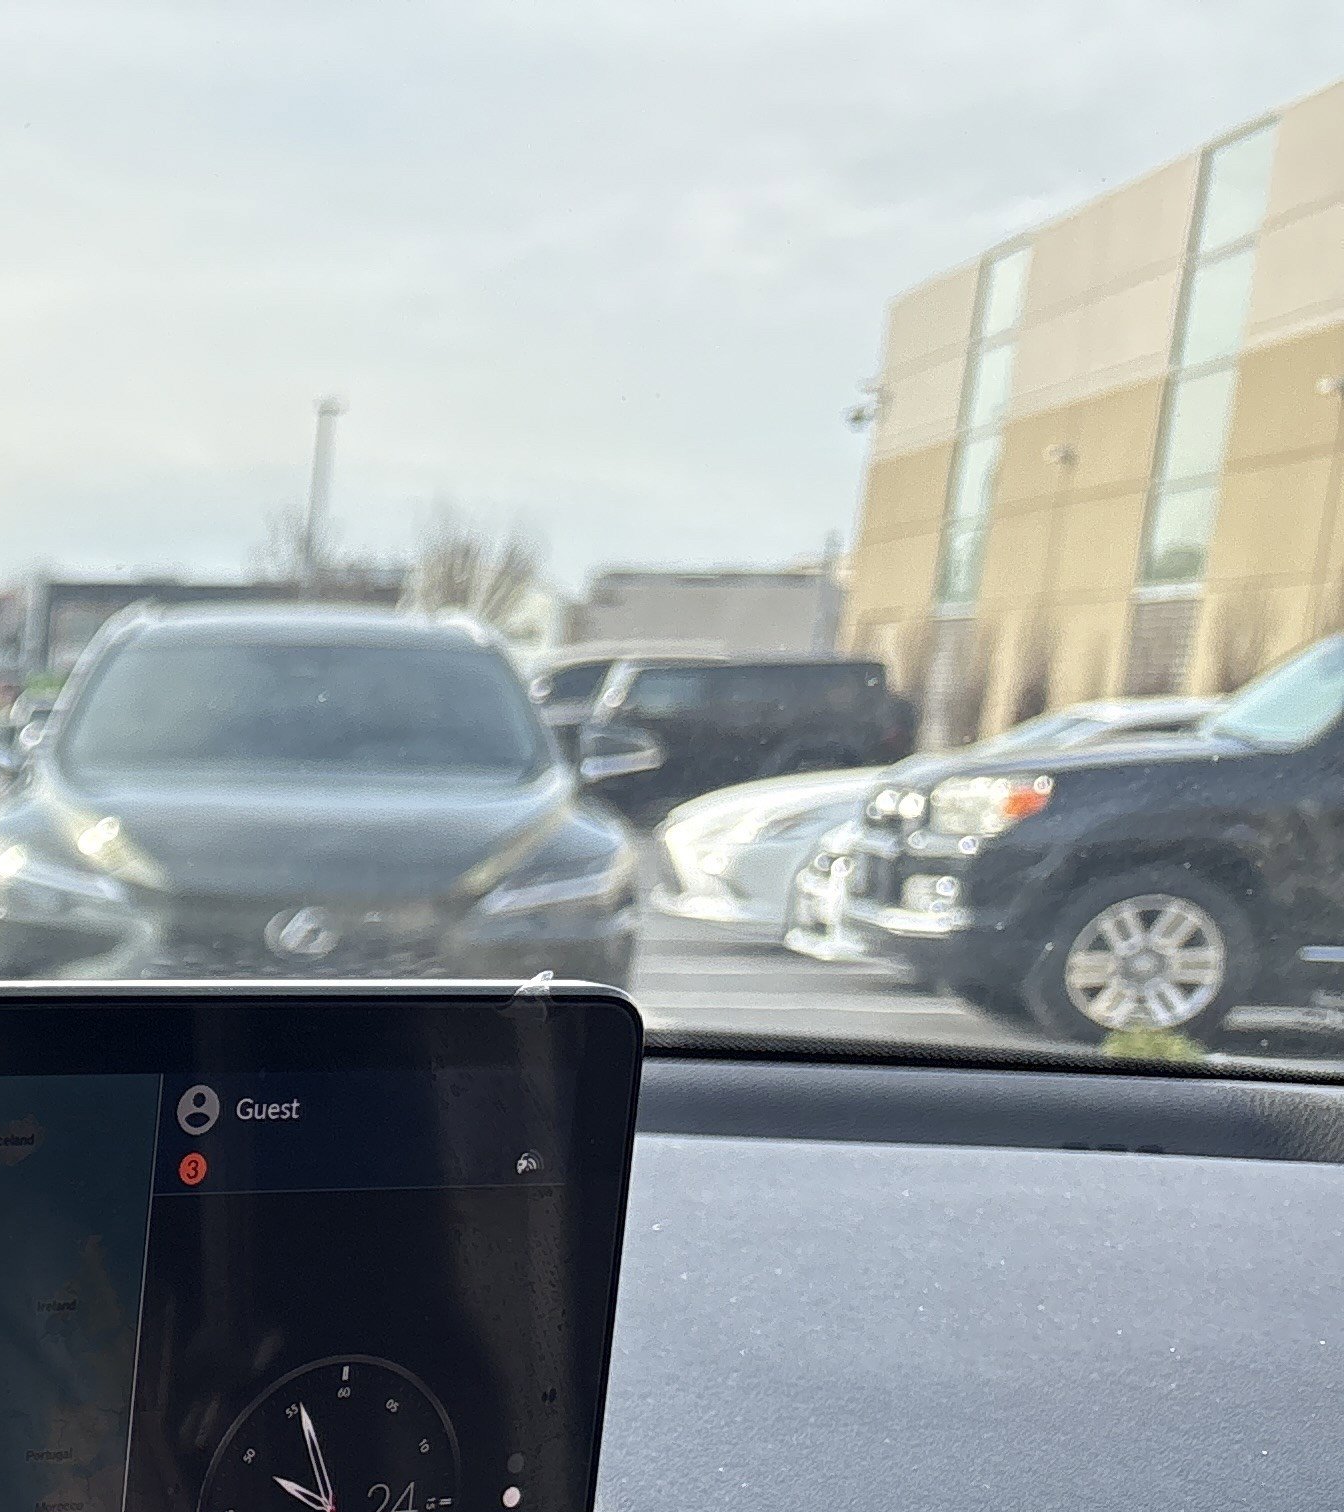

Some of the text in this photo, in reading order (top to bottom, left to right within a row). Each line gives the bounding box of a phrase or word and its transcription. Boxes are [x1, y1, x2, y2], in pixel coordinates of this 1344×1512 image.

[236, 1097, 300, 1122] Guest
[185, 1158, 200, 1180] 3
[38, 1301, 76, 1312] Ireland
[26, 1448, 73, 1463] Portugal
